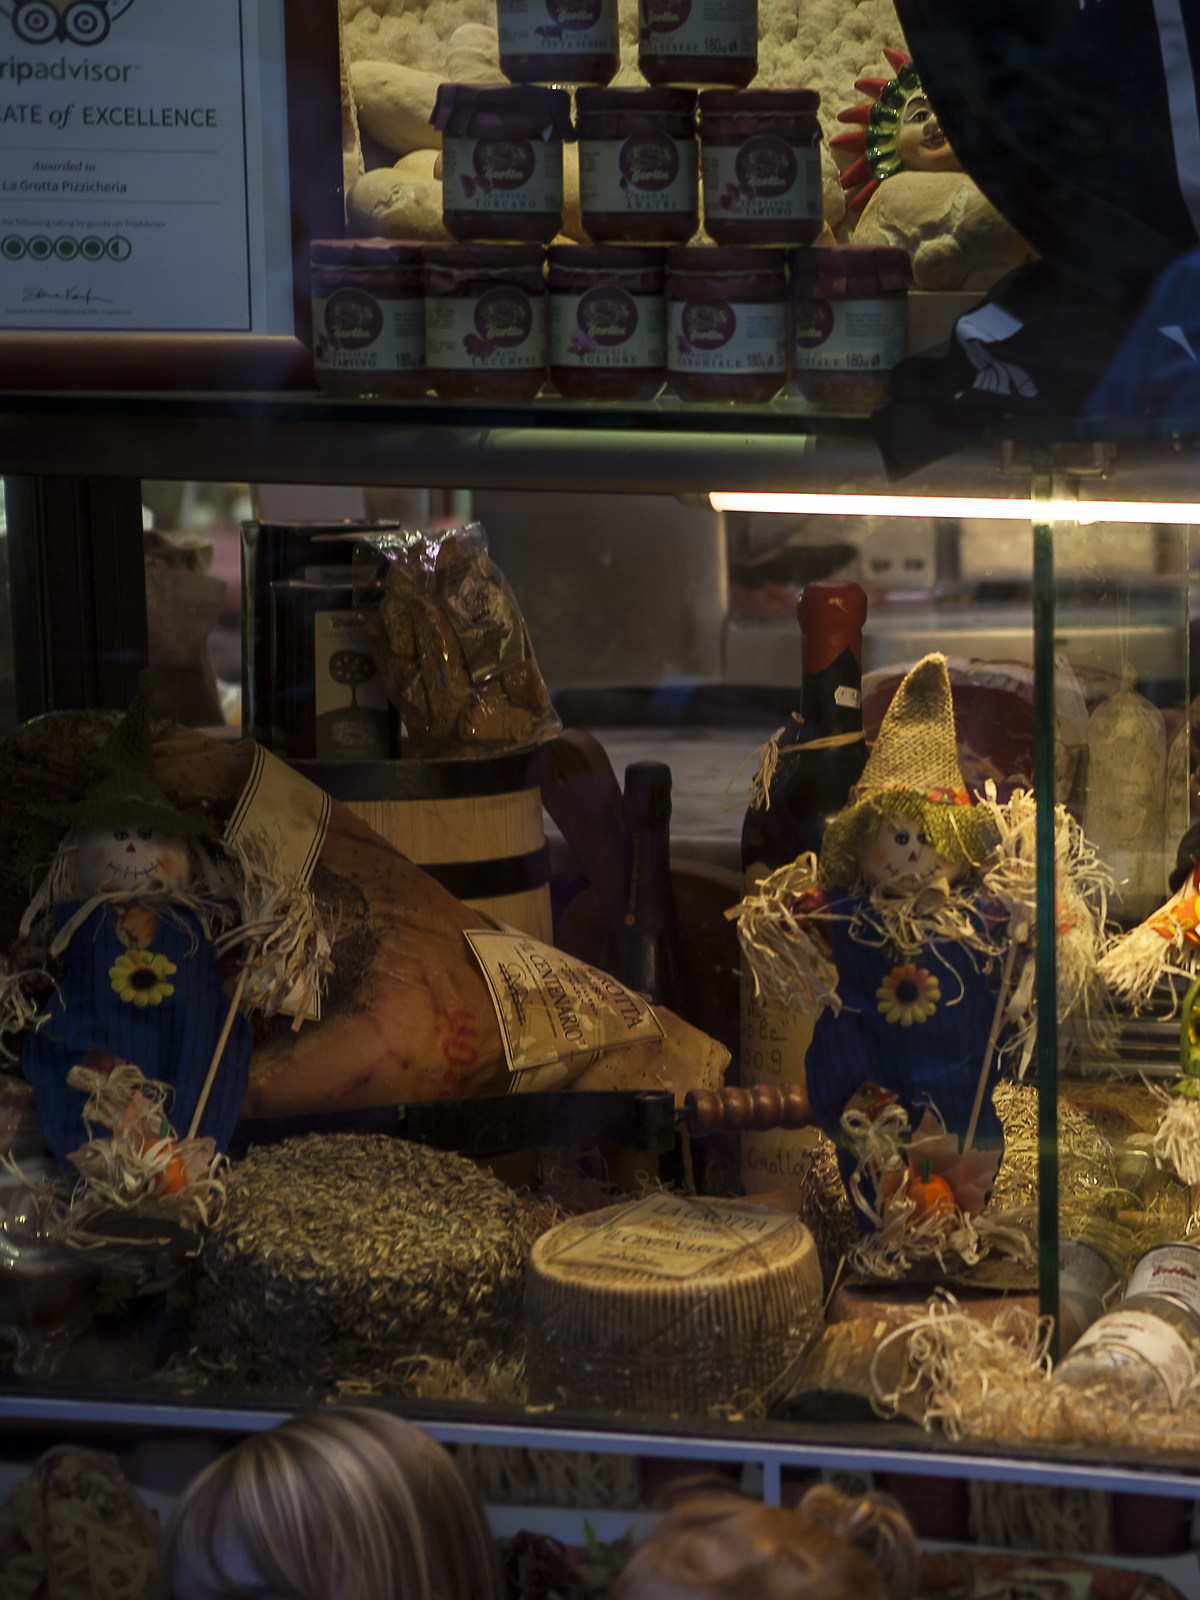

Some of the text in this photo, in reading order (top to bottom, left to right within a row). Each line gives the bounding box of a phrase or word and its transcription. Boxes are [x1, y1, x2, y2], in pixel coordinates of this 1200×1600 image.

[49, 104, 75, 129] of
[83, 106, 217, 127] EXCELLENCE
[32, 161, 96, 172] Awarded to
[2, 180, 127, 194] La Grotta Pizzicheria
